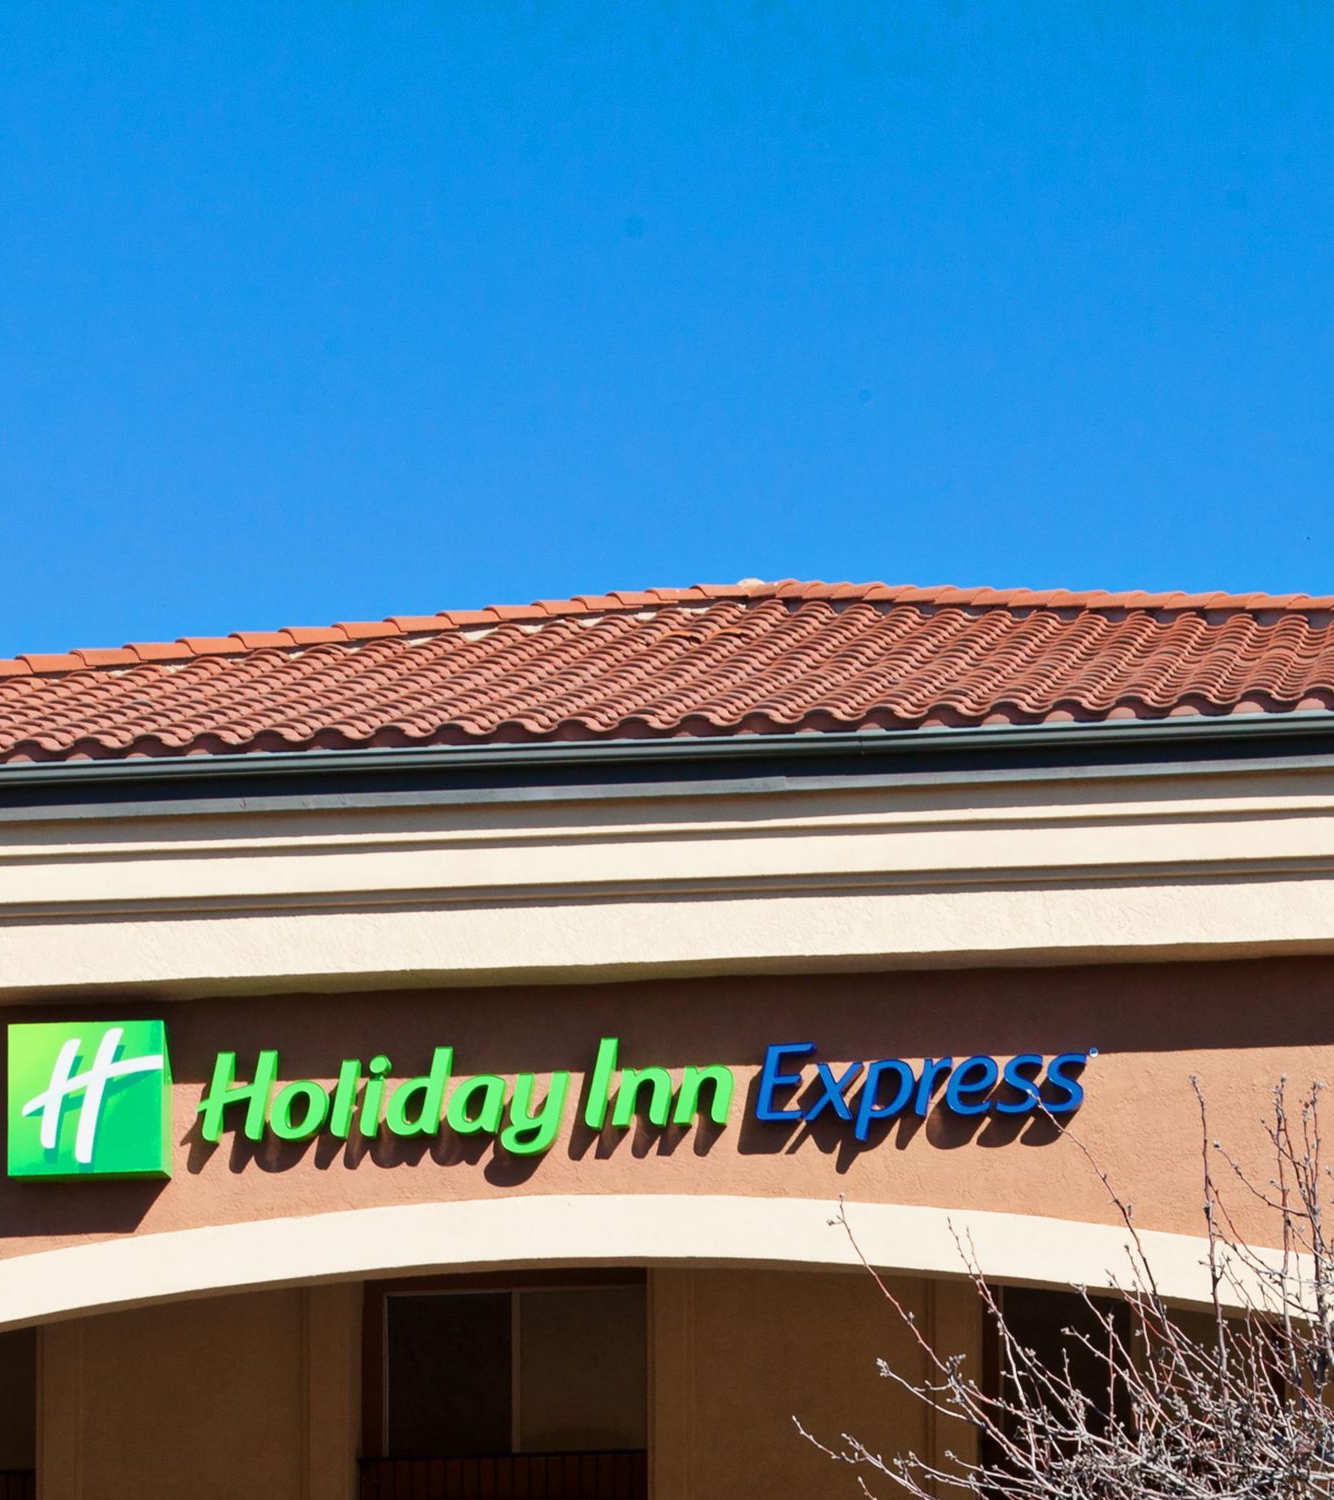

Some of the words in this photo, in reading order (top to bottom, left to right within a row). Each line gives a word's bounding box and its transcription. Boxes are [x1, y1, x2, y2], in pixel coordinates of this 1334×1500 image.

[196, 1046, 570, 1155] Holiday
[585, 1037, 733, 1131] Inn
[756, 1041, 1088, 1143] Express
